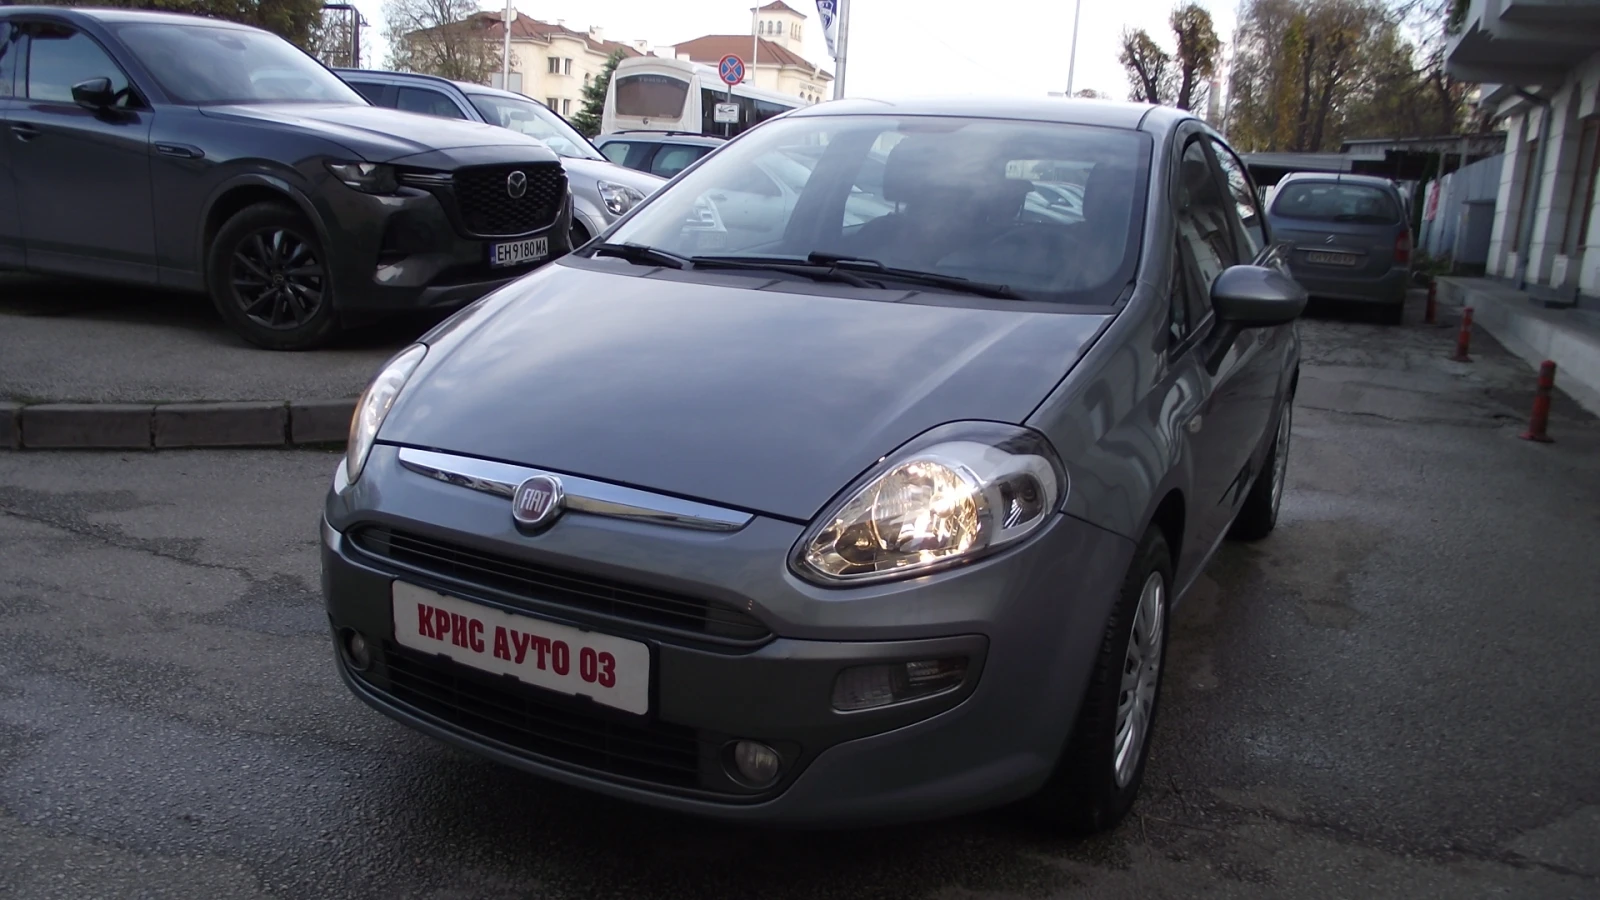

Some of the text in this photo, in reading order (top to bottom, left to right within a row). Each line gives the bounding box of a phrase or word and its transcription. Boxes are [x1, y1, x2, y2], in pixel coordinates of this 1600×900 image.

[520, 488, 550, 513] FIAT
[417, 603, 616, 688] КРИС АУТО 03
